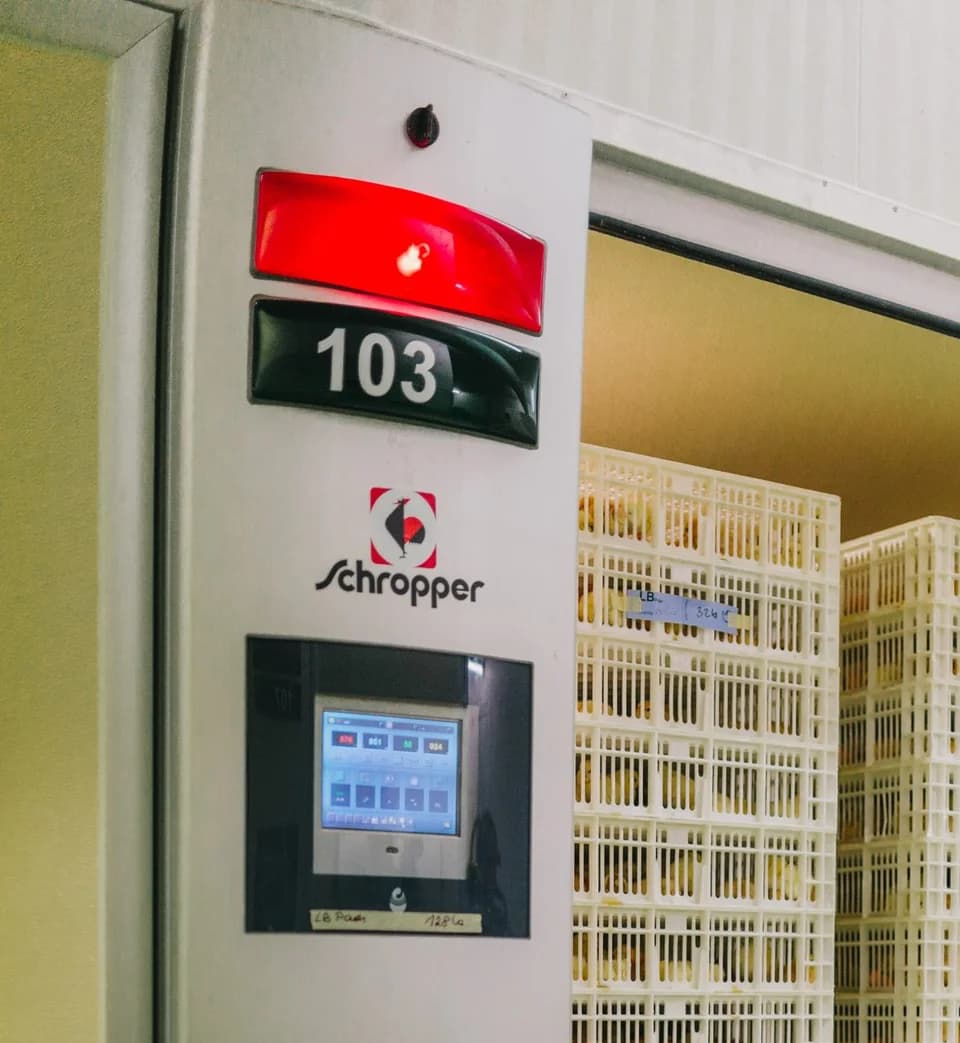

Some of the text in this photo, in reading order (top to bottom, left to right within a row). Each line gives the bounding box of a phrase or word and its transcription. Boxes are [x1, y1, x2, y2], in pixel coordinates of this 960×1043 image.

[317, 327, 437, 405] 103
[315, 559, 485, 609] Schropper
[640, 591, 654, 602] LB
